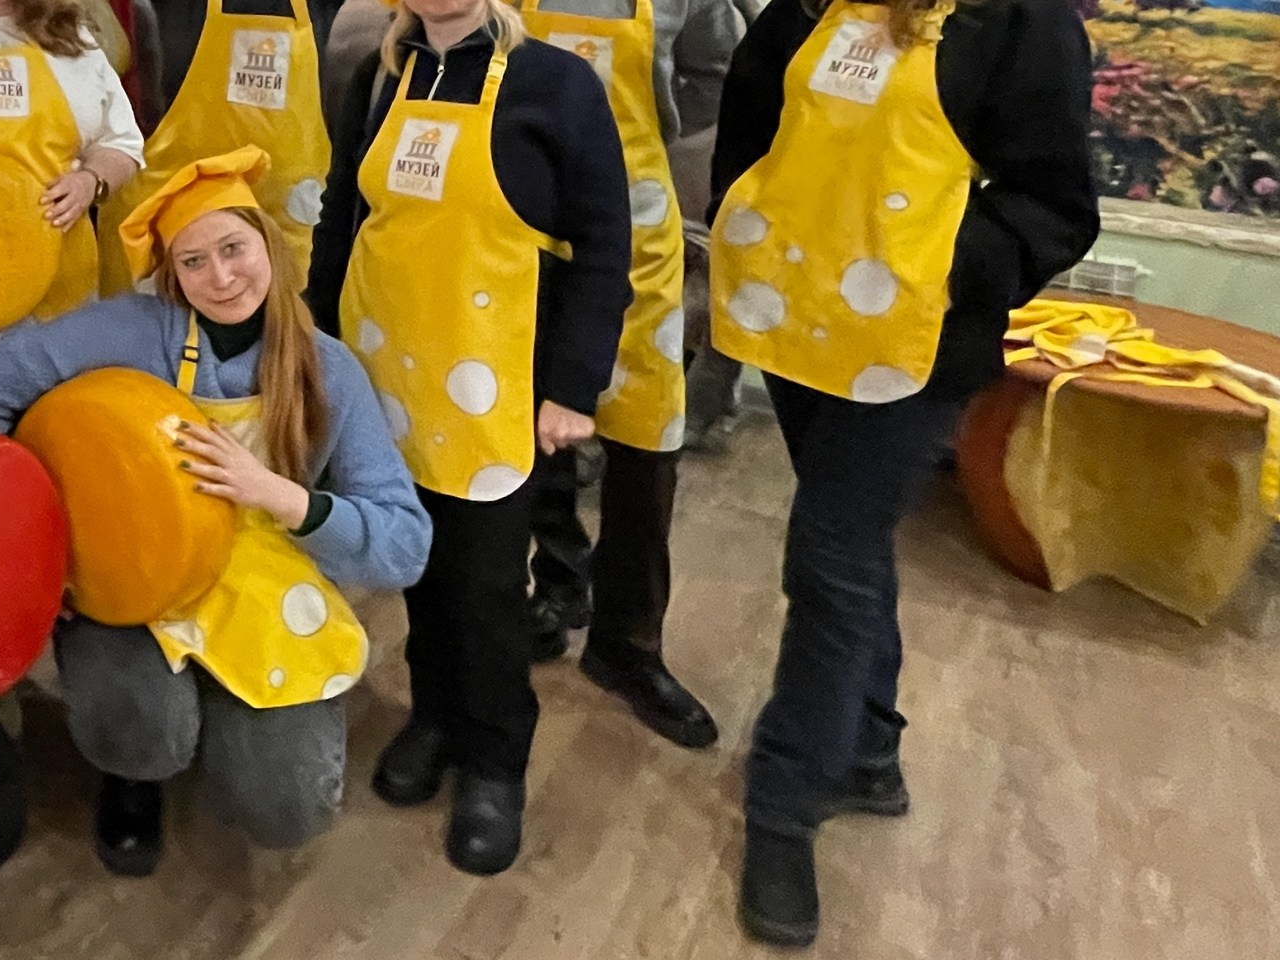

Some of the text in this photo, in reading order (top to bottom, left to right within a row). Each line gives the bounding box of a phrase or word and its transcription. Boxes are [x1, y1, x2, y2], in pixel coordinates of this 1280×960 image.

[828, 61, 879, 81] МУЗЕЙ
[235, 72, 282, 90] МУЗЕЙ
[395, 159, 440, 178] МУЗЕЙ
